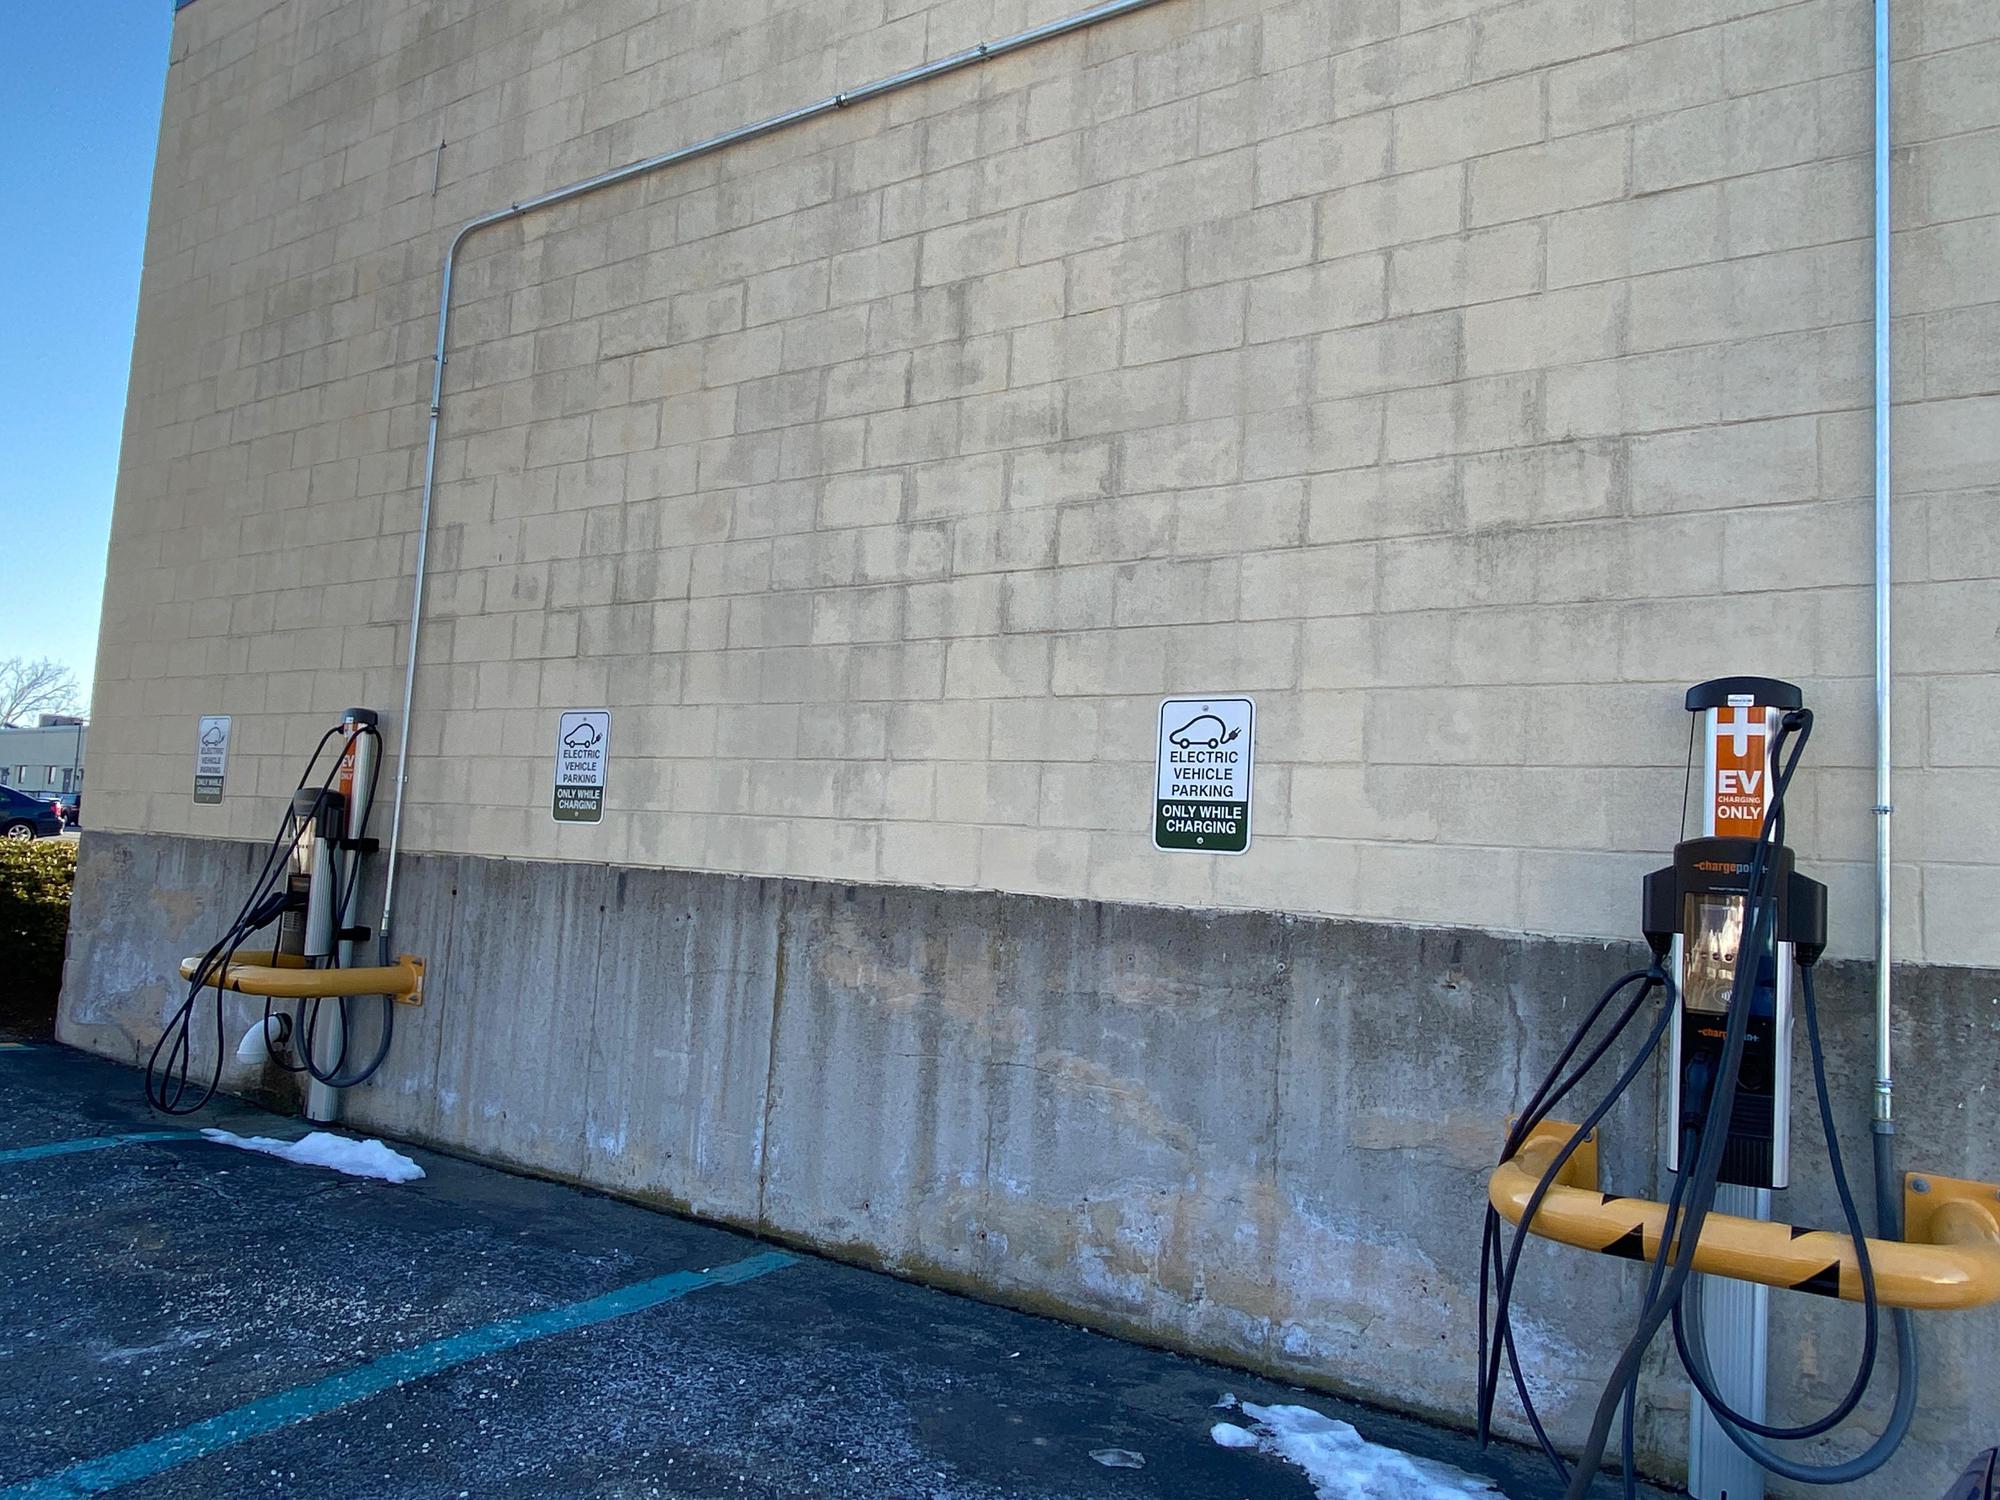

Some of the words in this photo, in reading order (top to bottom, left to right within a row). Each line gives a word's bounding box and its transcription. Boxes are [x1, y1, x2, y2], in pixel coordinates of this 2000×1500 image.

[563, 749, 601, 759] ELECTRIC
[1170, 751, 1239, 763] ELECTRIC
[565, 761, 597, 771] VEHICLE
[563, 774, 597, 784] PARKING
[1173, 768, 1233, 780] VEHICLE
[1718, 769, 1762, 794] EV
[557, 789, 576, 799] ONLY
[577, 789, 600, 799] WHILE
[1171, 784, 1234, 797] PARKING
[558, 799, 597, 810] CHARGING
[1717, 795, 1761, 804] CHARGING
[1162, 804, 1197, 818] ONLY
[1200, 805, 1242, 820] WHILE
[1717, 805, 1762, 820] ONLY
[1166, 819, 1236, 834] CHARGING
